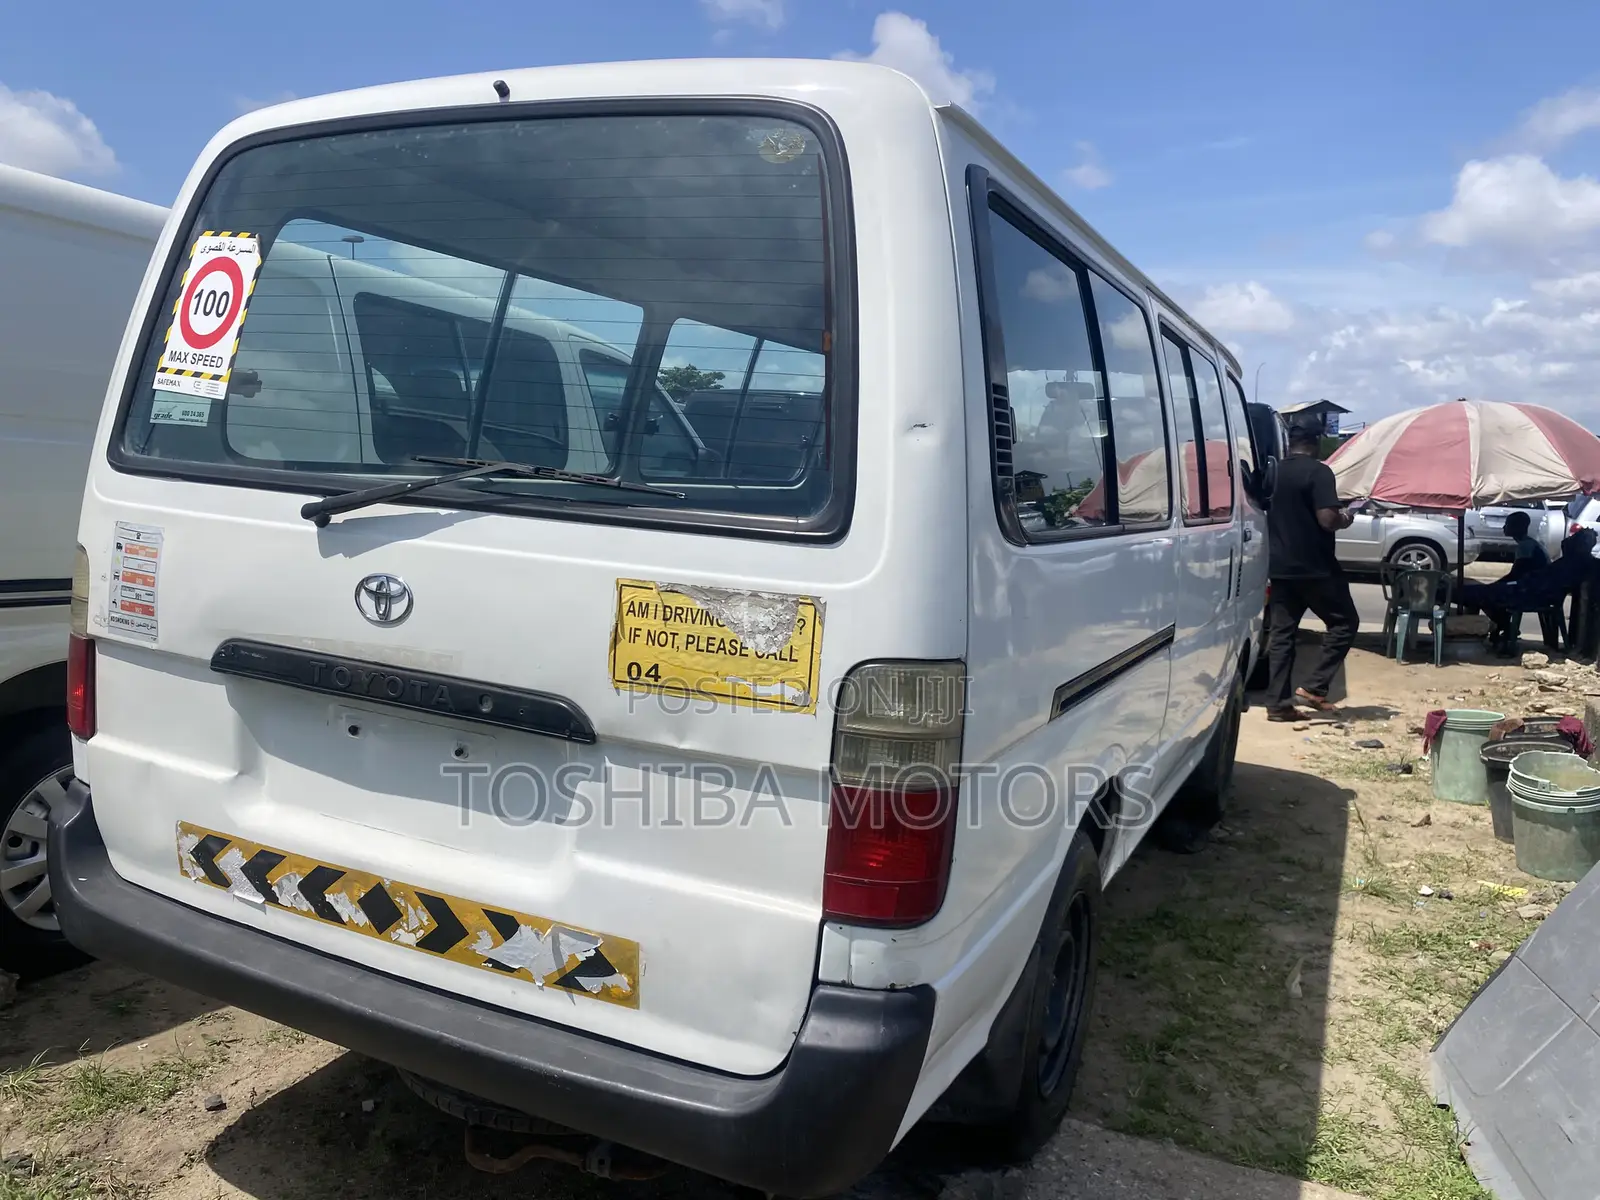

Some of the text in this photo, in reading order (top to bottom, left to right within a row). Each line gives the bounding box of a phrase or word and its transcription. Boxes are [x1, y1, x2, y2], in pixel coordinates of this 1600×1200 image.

[193, 288, 230, 318] 100
[168, 350, 224, 369] MAX SPEED
[157, 377, 181, 387] SAFEMAX
[626, 600, 649, 619] AM
[653, 602, 658, 620] I
[628, 627, 642, 644] IF
[646, 629, 680, 653] NOT,
[685, 634, 749, 658] PLEASE
[626, 661, 662, 683] 04
[307, 660, 456, 712] TOYOTA
